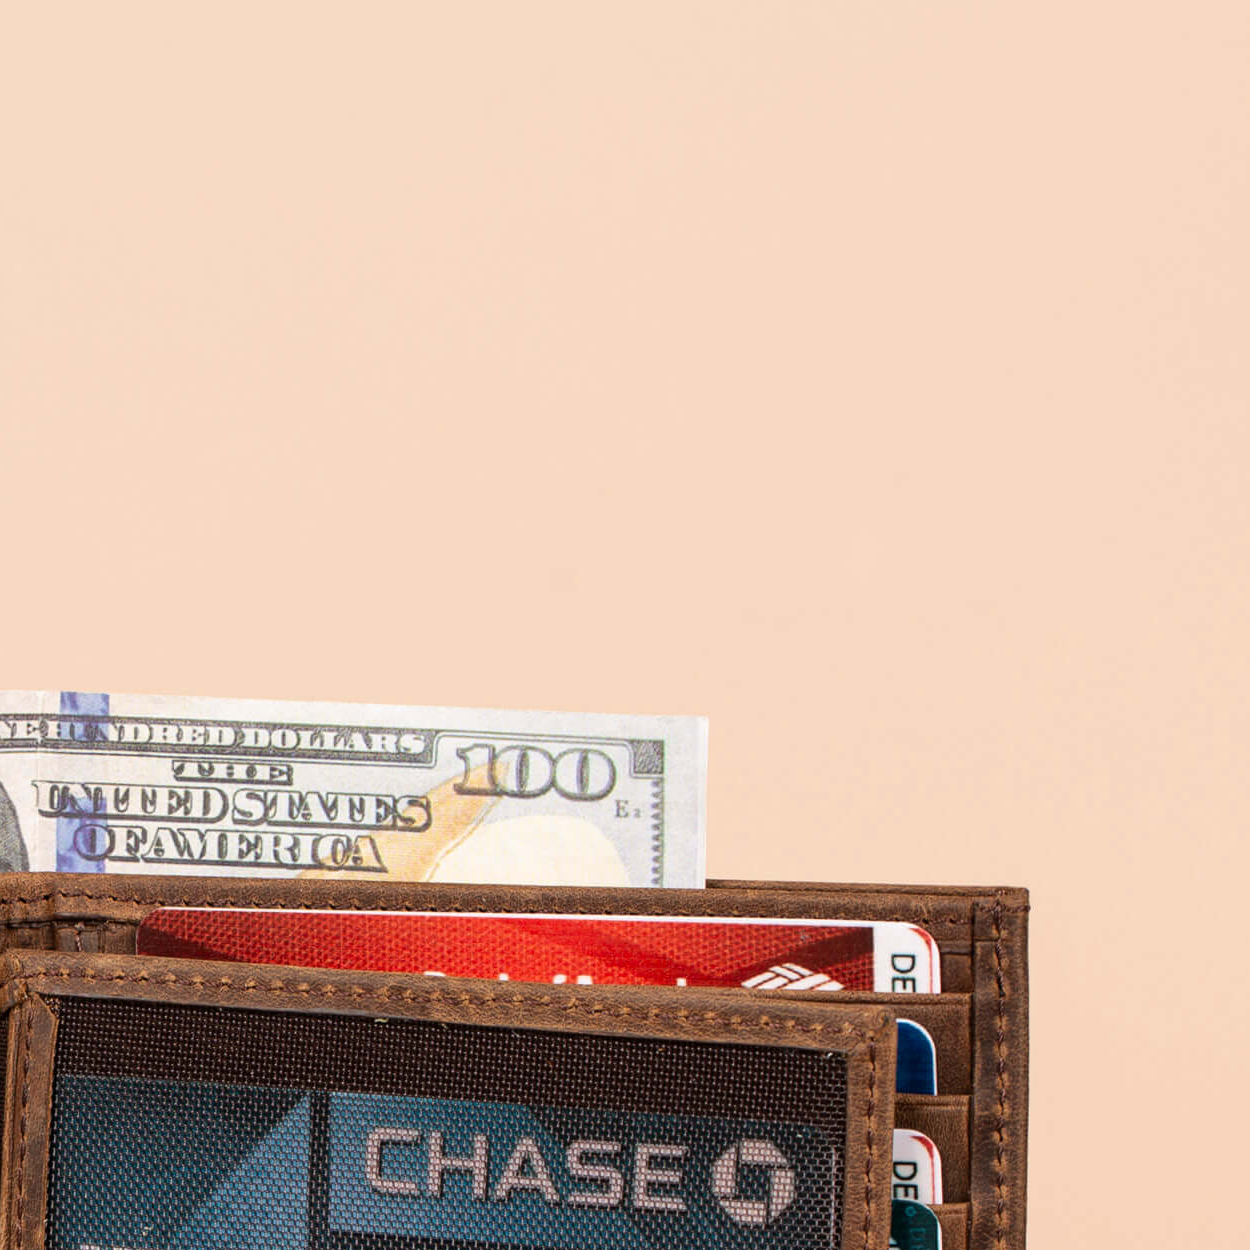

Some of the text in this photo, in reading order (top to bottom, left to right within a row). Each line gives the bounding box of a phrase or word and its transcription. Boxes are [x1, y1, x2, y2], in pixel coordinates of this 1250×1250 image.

[47, 721, 237, 748] HUNDRED
[241, 728, 426, 754] DOLLARS
[172, 760, 294, 785] THE
[453, 743, 617, 801] 100
[31, 780, 432, 832] UNITED STATES
[73, 824, 388, 873] OF AMERICA
[364, 1125, 690, 1213] CHASE
